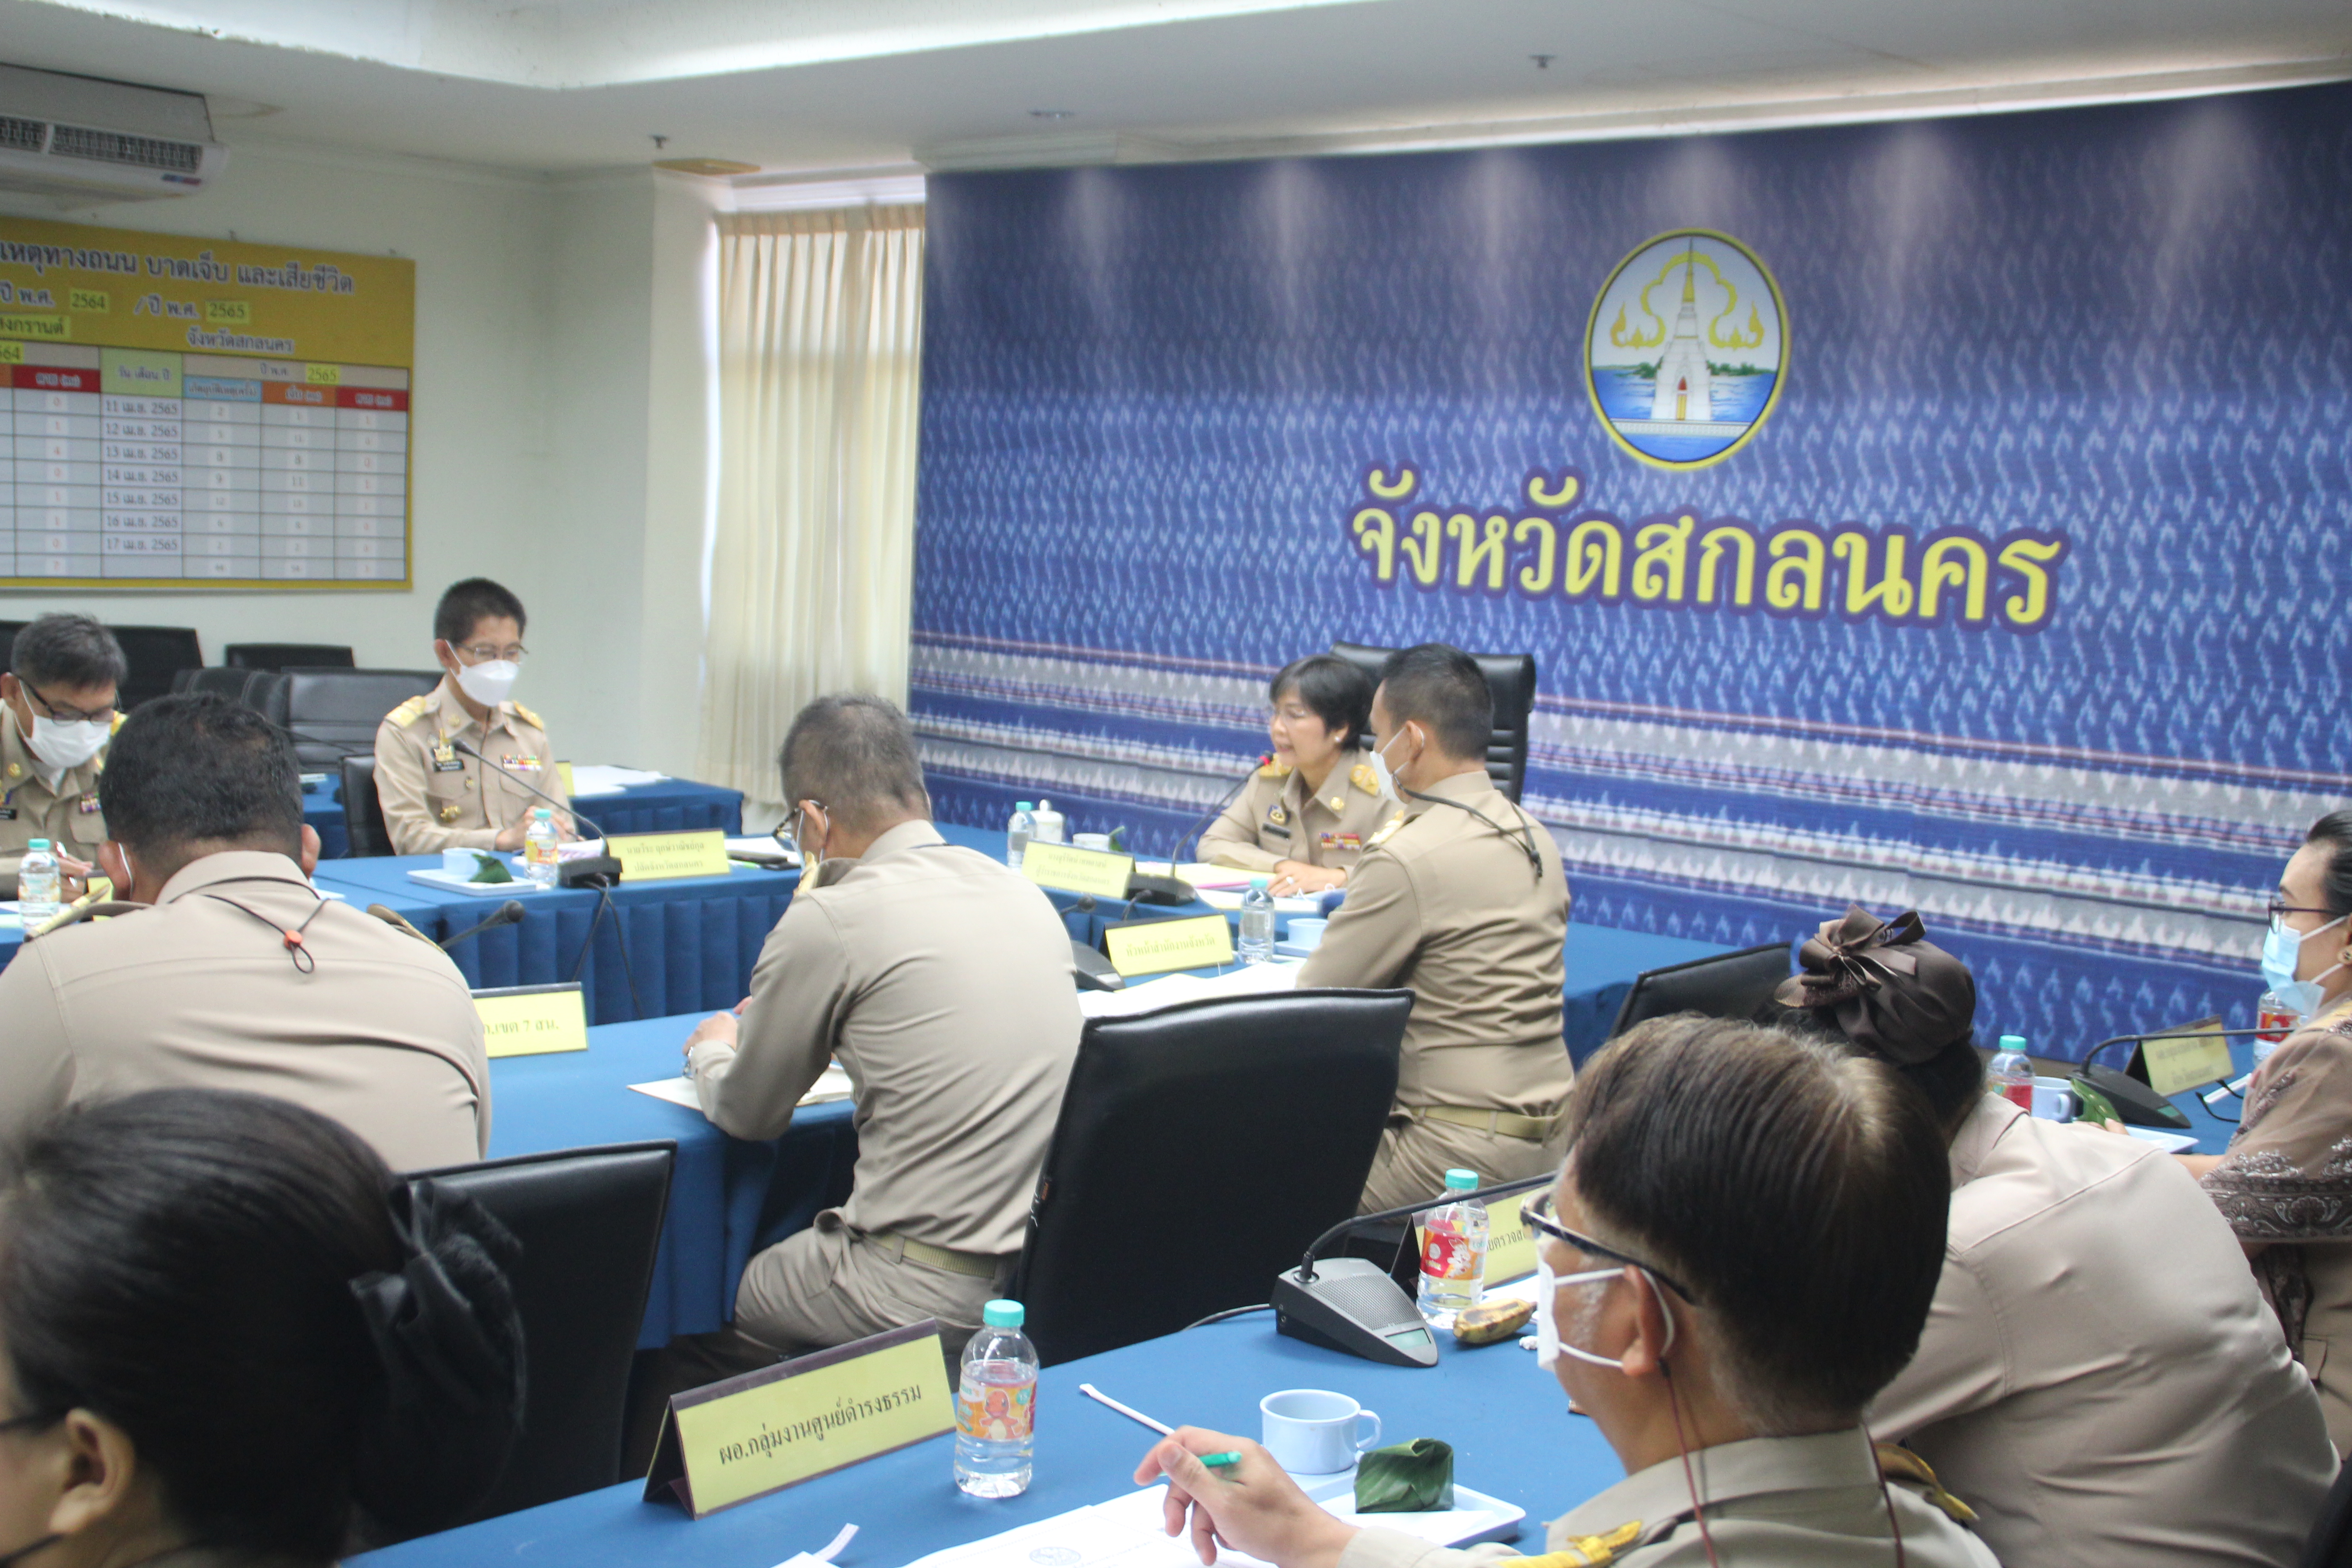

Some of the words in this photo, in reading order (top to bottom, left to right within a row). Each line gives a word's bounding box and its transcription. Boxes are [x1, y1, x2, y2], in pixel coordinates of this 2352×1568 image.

[145, 250, 230, 283] บาดเจ็บ
[237, 260, 355, 295] และเสียชีวิต
[18, 288, 55, 308] พ.ศ.
[72, 292, 106, 310] 2564
[166, 301, 200, 319] พ.ศ.
[209, 301, 245, 318] 2565
[187, 325, 294, 354] จังหวัดสกลนคร
[307, 366, 337, 381] 2565
[105, 400, 118, 411] 11
[151, 403, 177, 414] 2565
[105, 423, 118, 434] 12
[151, 425, 177, 436] 2565
[105, 446, 118, 457] 13
[151, 447, 177, 459] 2565
[106, 469, 119, 480] 14
[152, 470, 178, 482] 2565
[106, 492, 119, 503] 15
[152, 493, 178, 505] 2565
[106, 515, 119, 527] 16
[152, 516, 178, 527] 2565
[106, 538, 119, 549] 17
[152, 539, 178, 550] 2565
[1352, 469, 2061, 624] จังหวัดสกลนคร
[1126, 933, 1215, 957] หัวหน้าสำนักงานจังหวัด
[523, 1020, 529, 1032] 7
[719, 1384, 922, 1465] ผอ.กลุ่มงานศูนย์ดำรงธรรม
